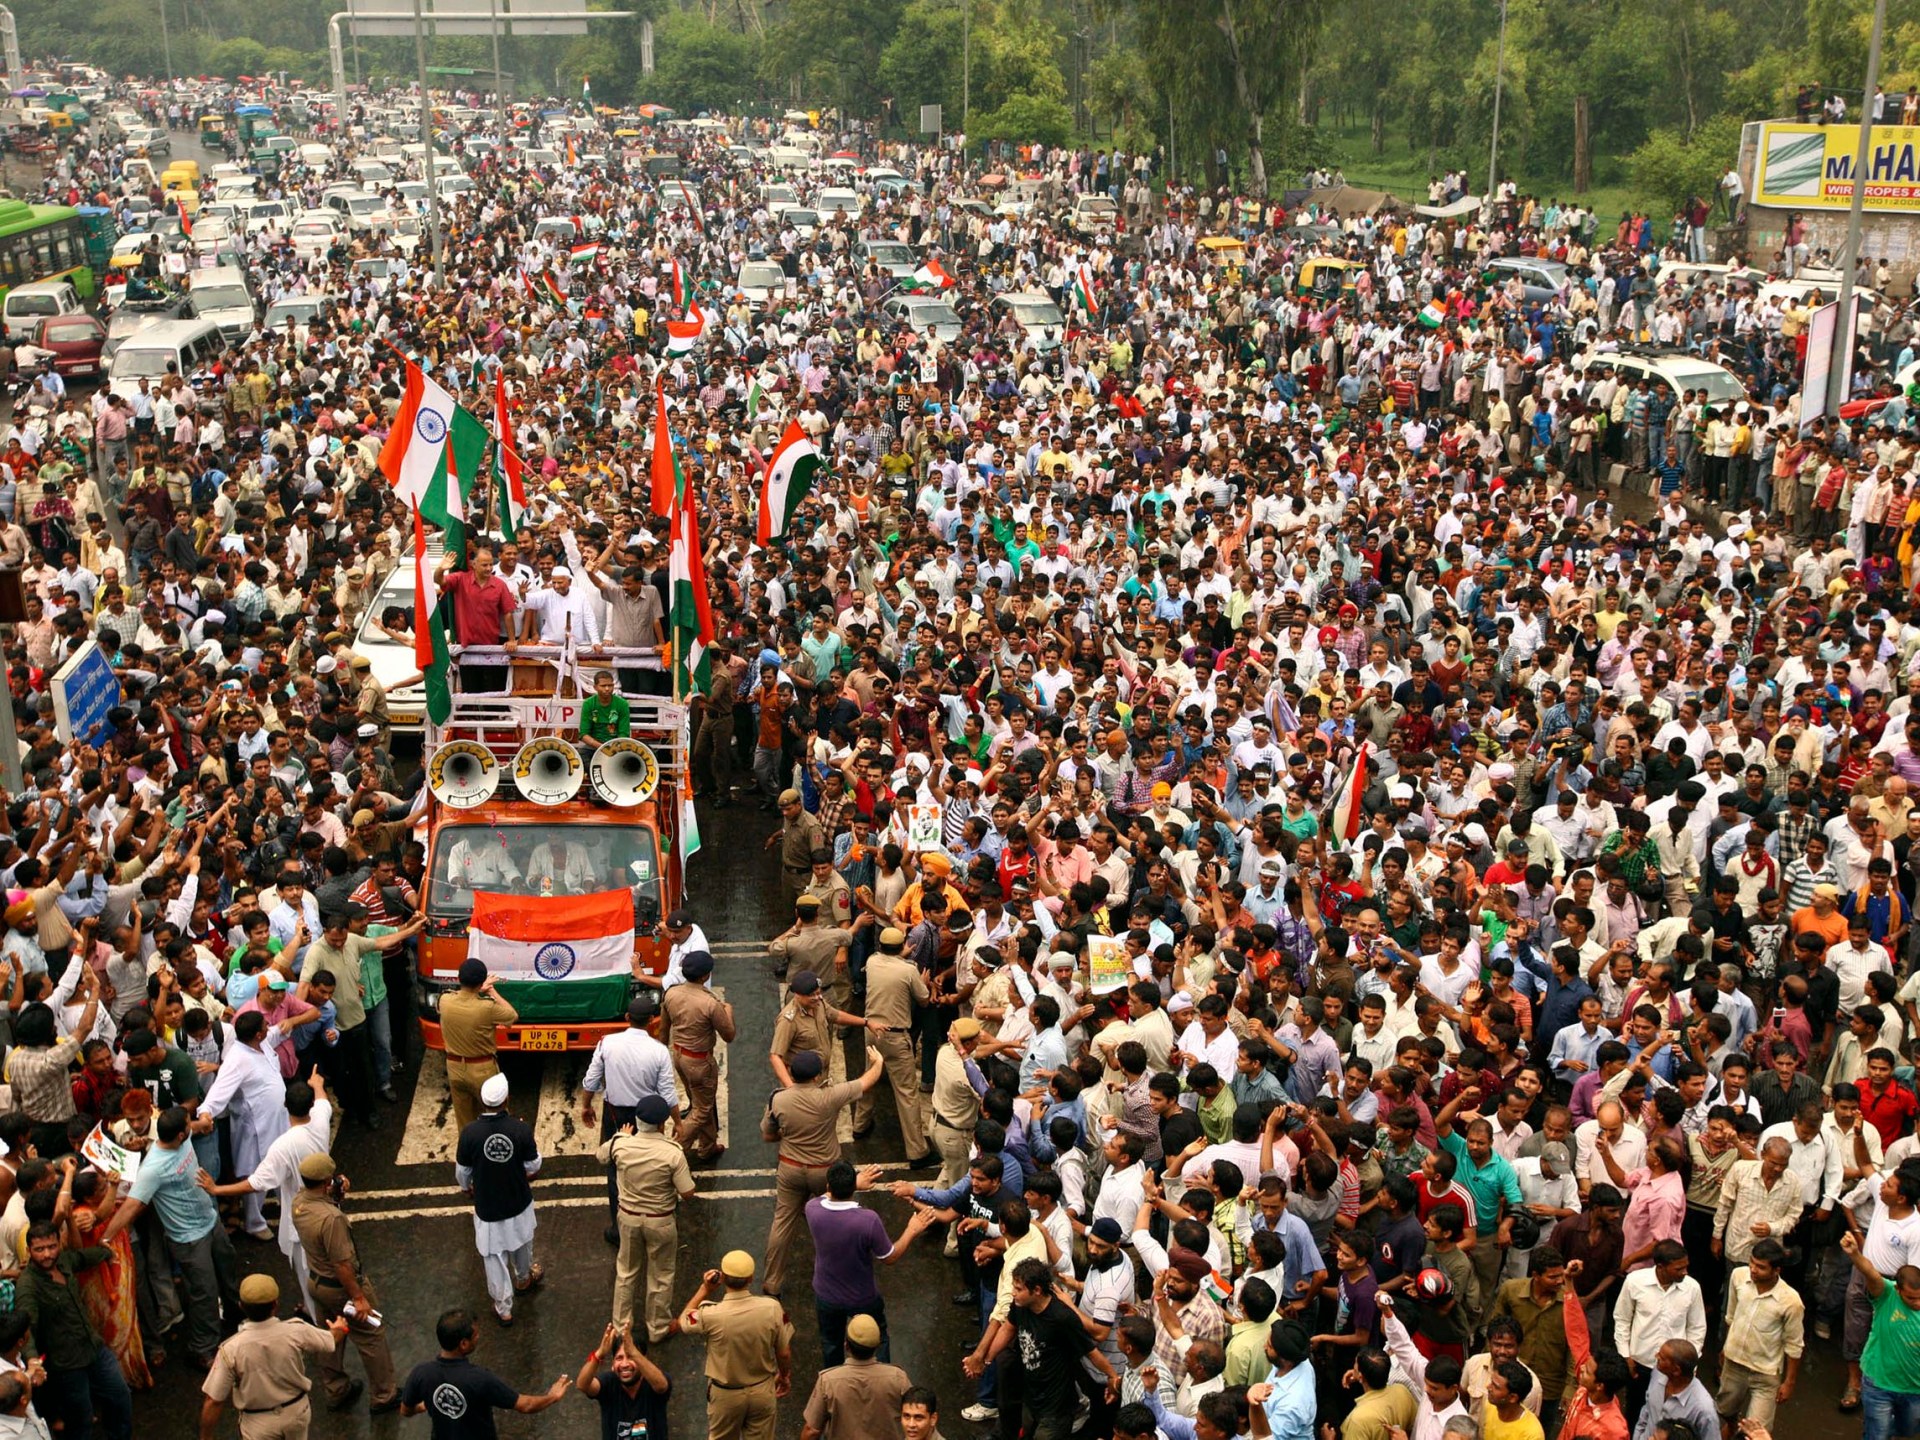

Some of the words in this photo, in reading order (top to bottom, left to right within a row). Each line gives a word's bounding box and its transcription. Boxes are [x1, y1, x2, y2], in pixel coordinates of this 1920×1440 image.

[1825, 143, 1920, 182] MHA
[1827, 185, 1853, 194] WIR
[1863, 187, 1910, 197] ROPES
[535, 706, 547, 722] N
[562, 706, 574, 722] P
[530, 1031, 542, 1040] UP
[546, 1031, 558, 1040] 16
